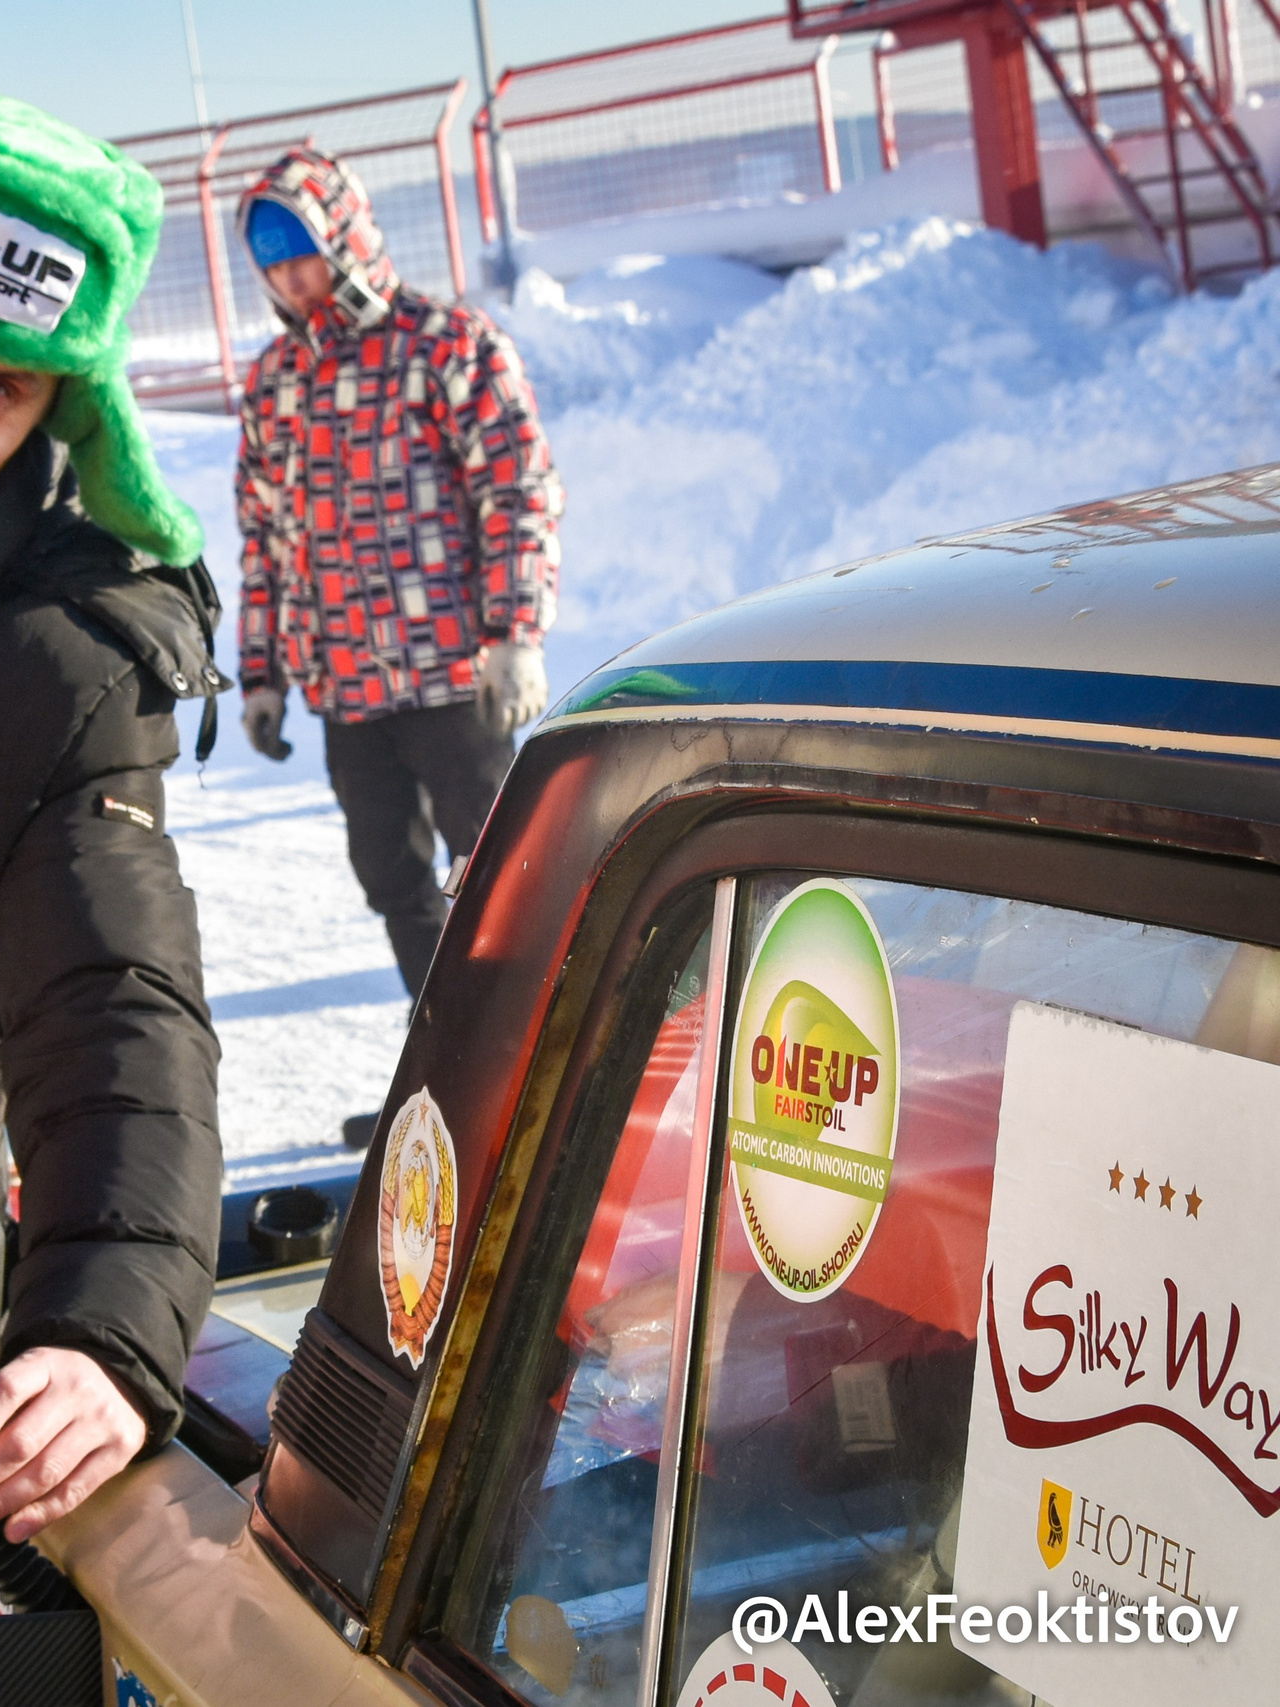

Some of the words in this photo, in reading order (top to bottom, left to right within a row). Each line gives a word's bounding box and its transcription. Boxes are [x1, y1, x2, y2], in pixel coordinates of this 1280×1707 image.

[0, 239, 75, 284] UP
[751, 1034, 823, 1097] ONE
[828, 1050, 879, 1107] UP
[774, 1093, 846, 1132] FAIRSTOIL
[731, 1130, 768, 1158] ATOMIC
[769, 1140, 812, 1170] CARBON
[813, 1151, 886, 1190] INNOVATIONS
[742, 1188, 864, 1291] WWW.ONE-UP-OIL-SHOP.RU
[1018, 1264, 1148, 1393] Silky
[1163, 1277, 1280, 1460] Way
[1075, 1496, 1201, 1606] HOTEL
